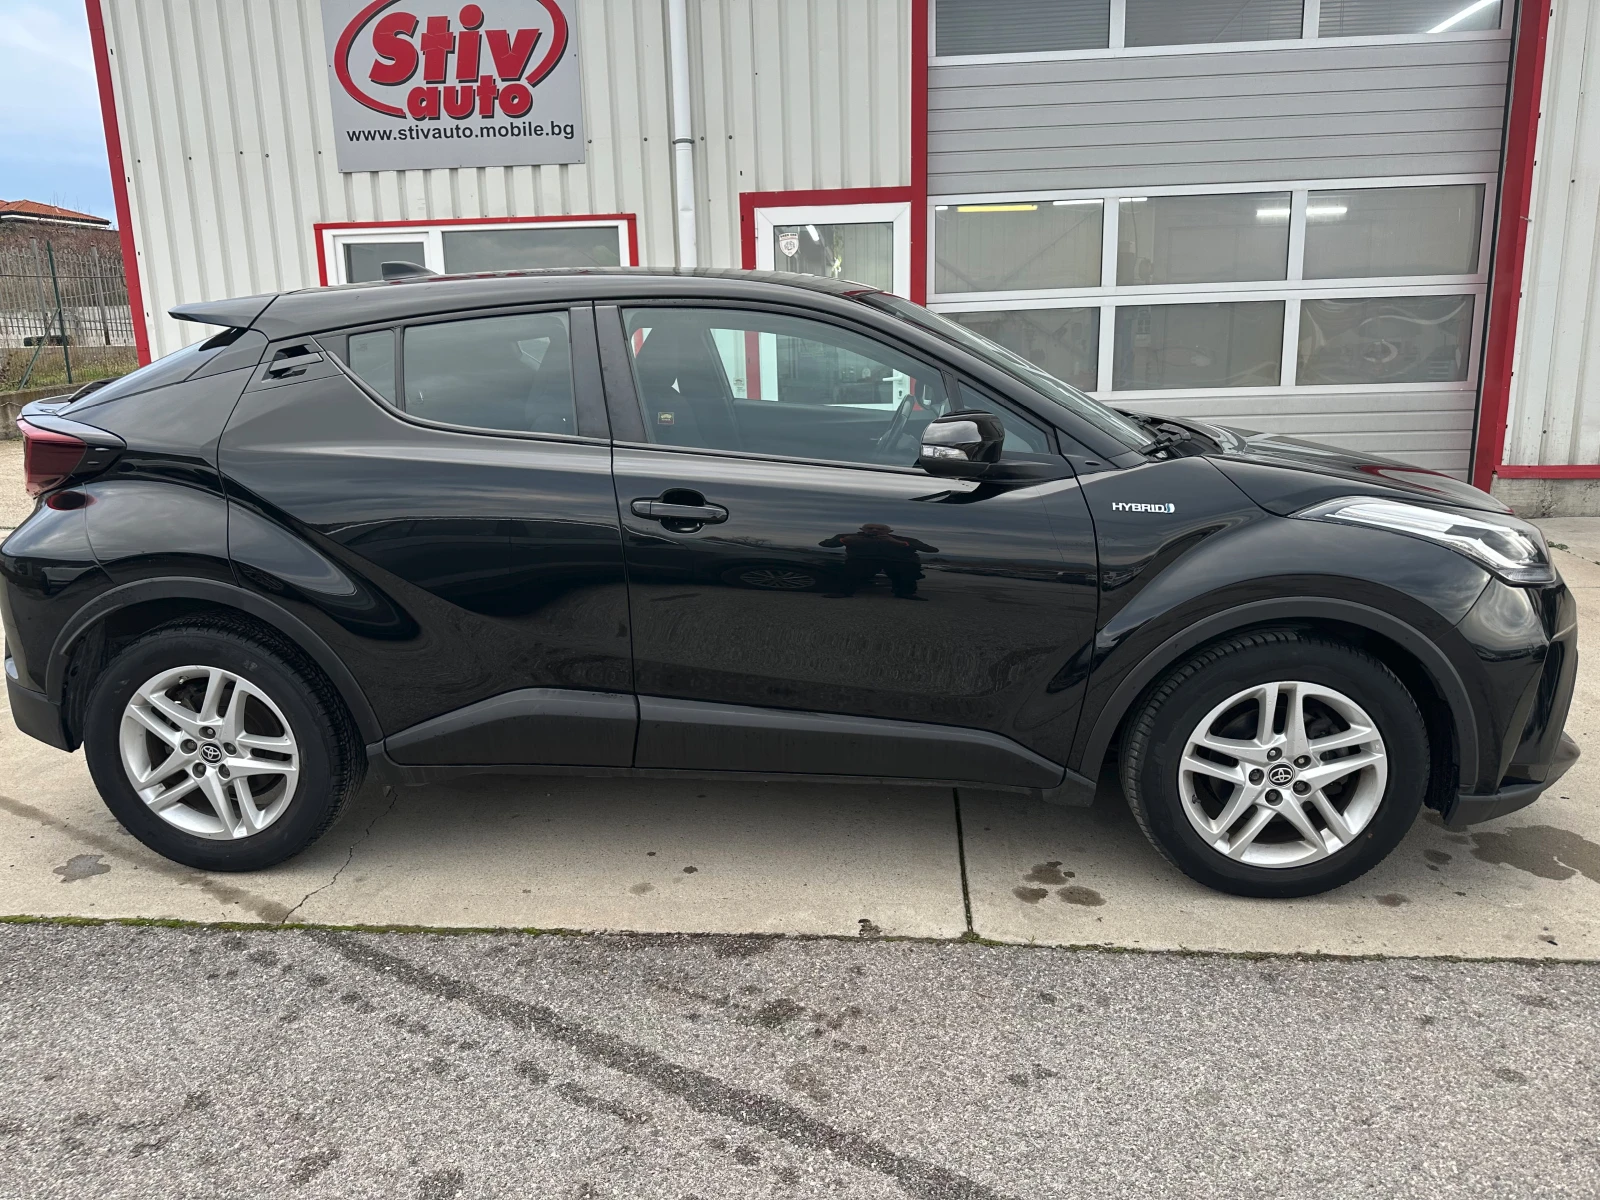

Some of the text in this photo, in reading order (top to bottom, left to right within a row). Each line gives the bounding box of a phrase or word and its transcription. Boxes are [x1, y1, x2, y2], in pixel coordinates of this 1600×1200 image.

[369, 4, 542, 86] Stiv
[407, 75, 533, 121] auto
[346, 121, 575, 142] www.stivauto.mobile.bg
[1112, 502, 1164, 513] HYBRID
